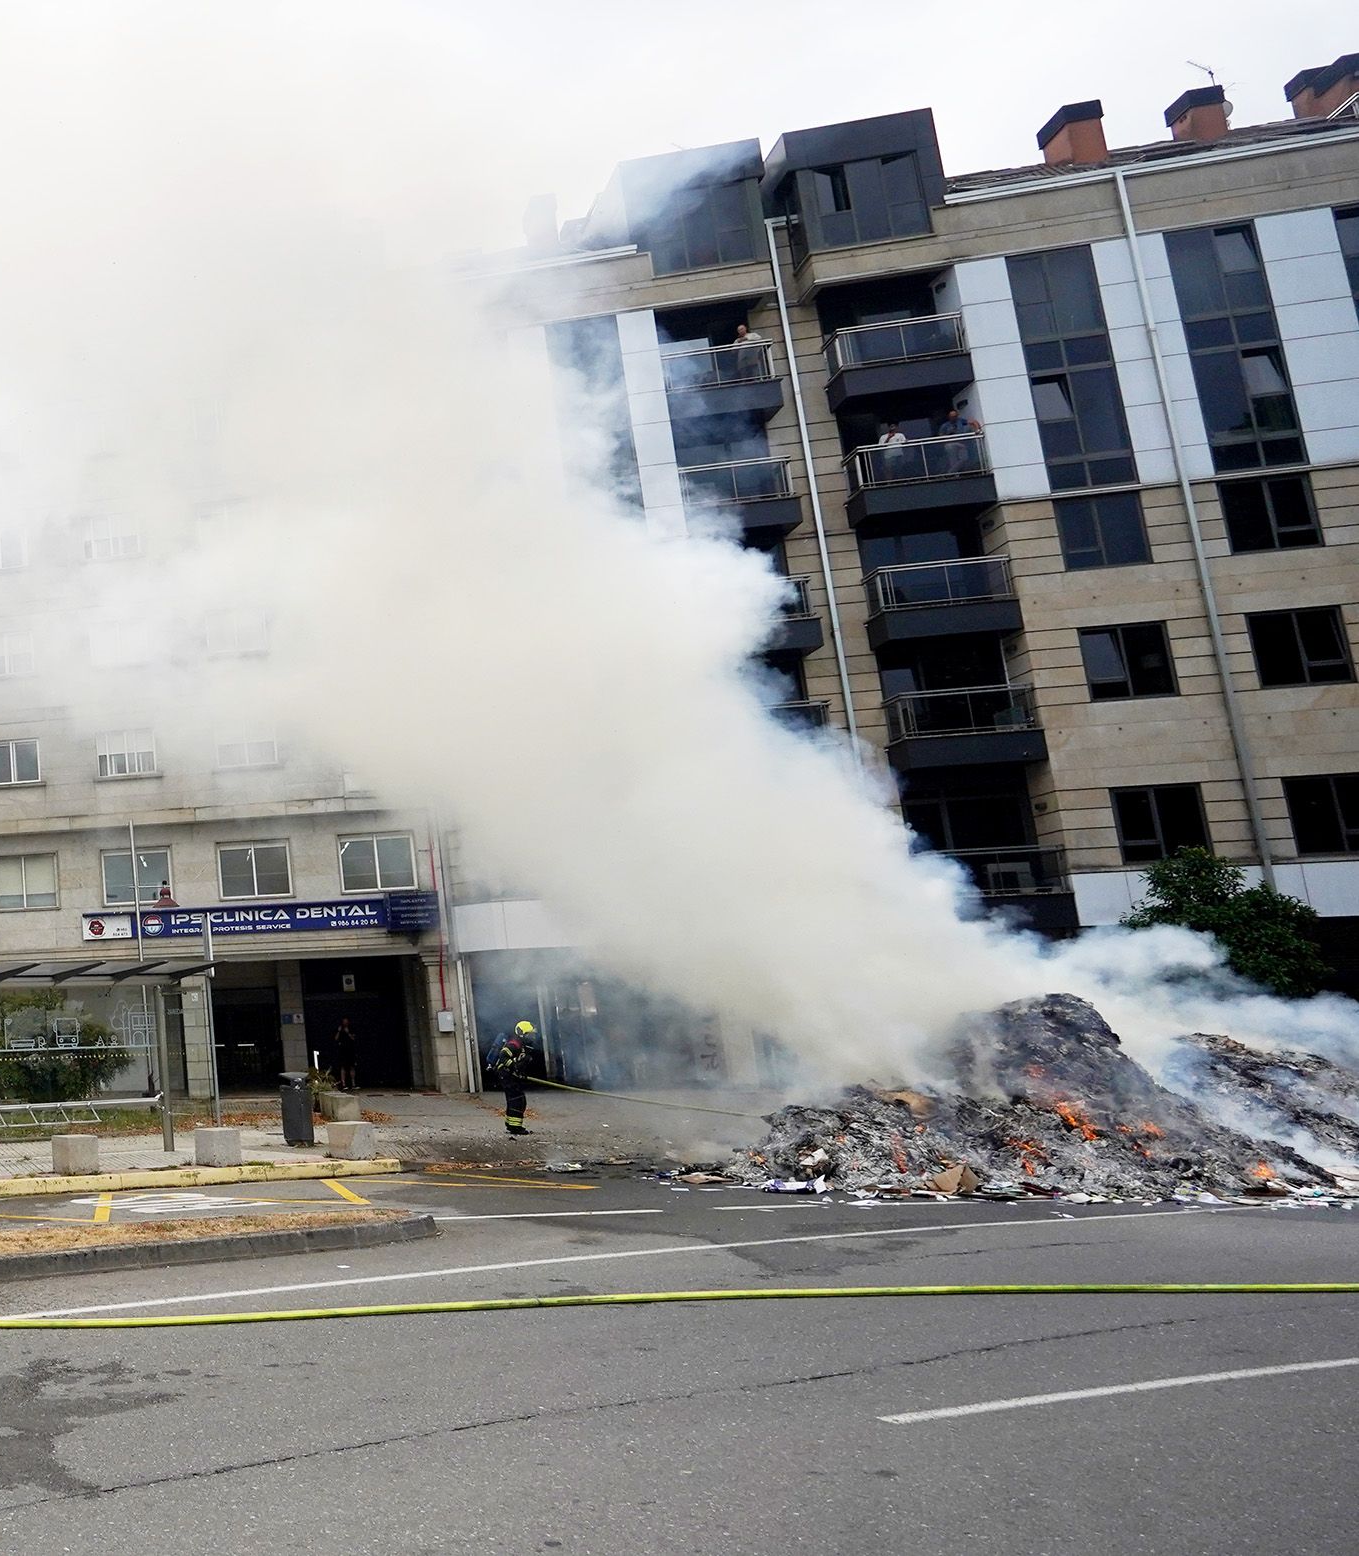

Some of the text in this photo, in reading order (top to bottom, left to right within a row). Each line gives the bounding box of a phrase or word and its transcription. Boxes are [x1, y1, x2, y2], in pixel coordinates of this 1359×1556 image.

[170, 913, 205, 925] IPS
[209, 909, 291, 924] CLINICA
[296, 904, 378, 919] DENTAL
[212, 924, 254, 932] PROTESIS
[256, 923, 292, 931] SERVICE
